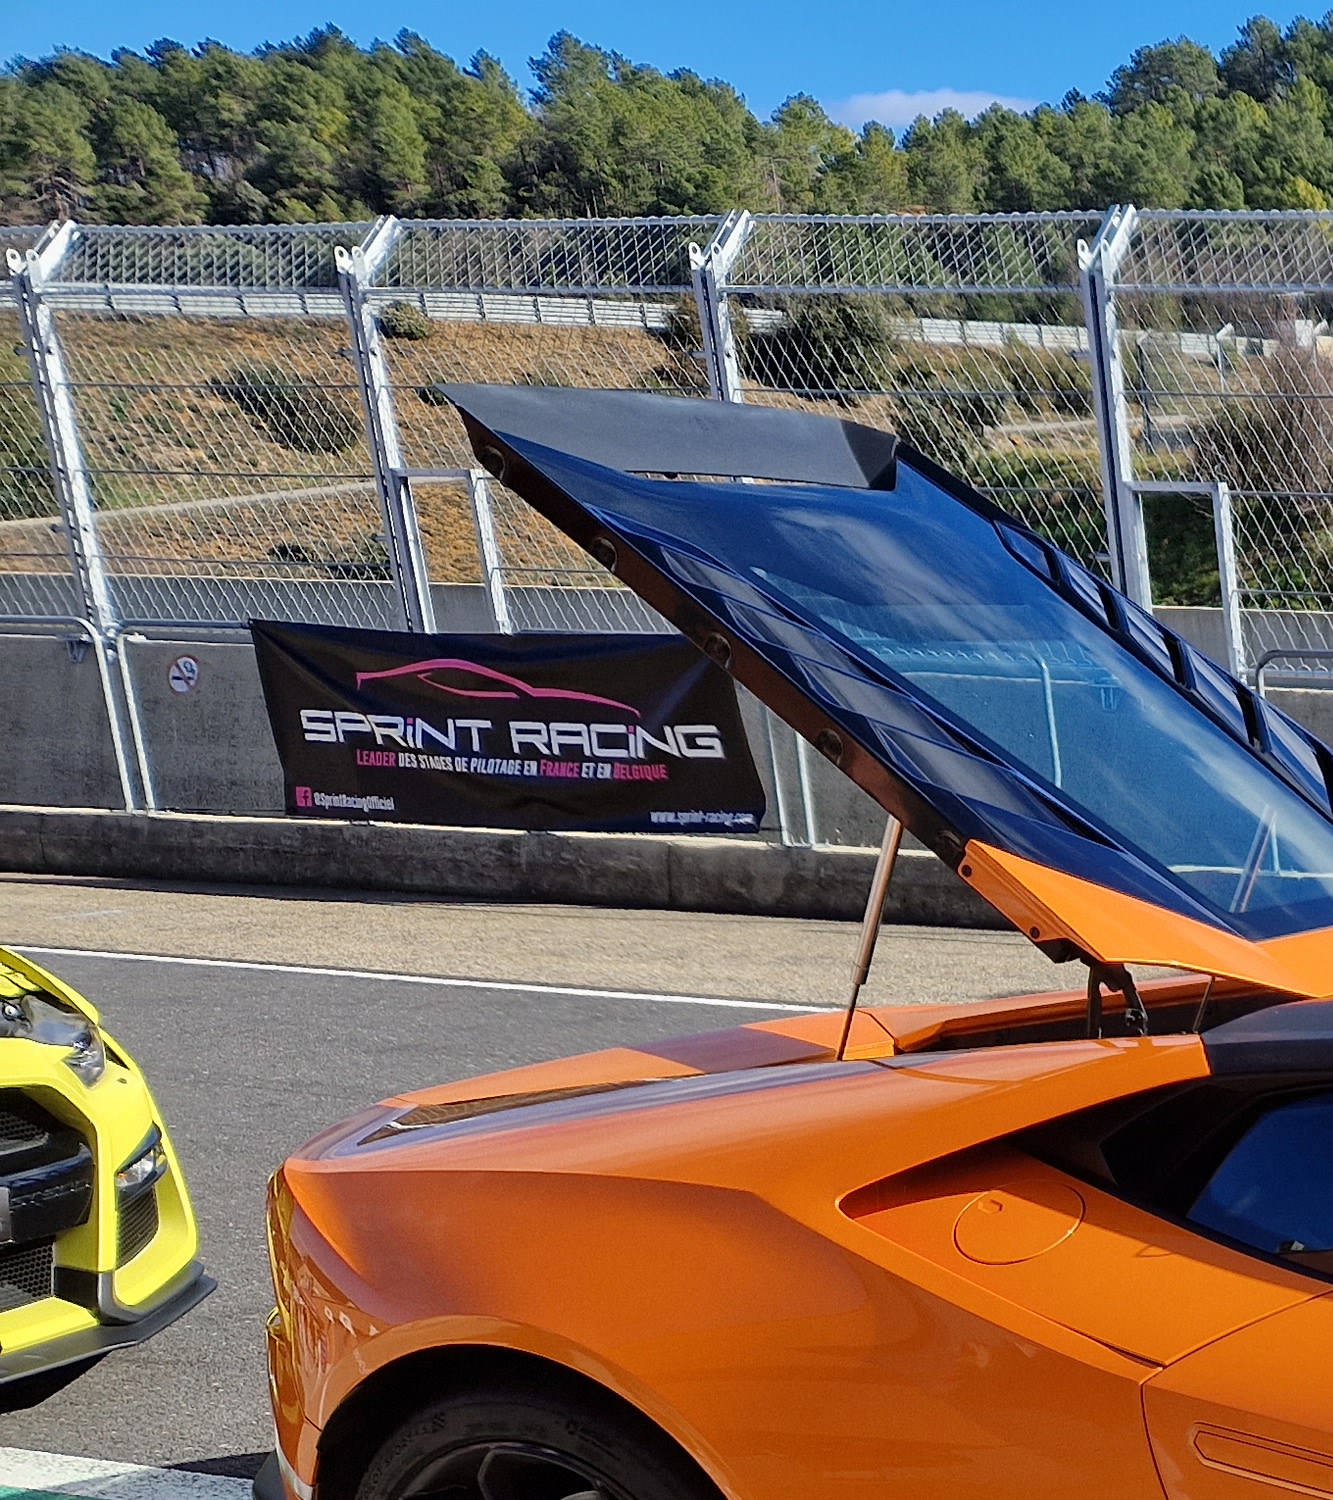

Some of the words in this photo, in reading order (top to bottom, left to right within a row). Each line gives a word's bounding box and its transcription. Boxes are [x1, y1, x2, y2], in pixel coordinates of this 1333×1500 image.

[356, 749, 396, 767] LEADER
[398, 752, 418, 768] DES
[419, 754, 454, 772] STAGES
[454, 757, 469, 773] DE
[470, 758, 522, 775] PILOTAGE
[523, 760, 538, 776] EN
[539, 759, 580, 778] FRANCE
[581, 762, 597, 778] ET
[597, 763, 612, 779] EN
[612, 763, 669, 781] BELGIQUE
